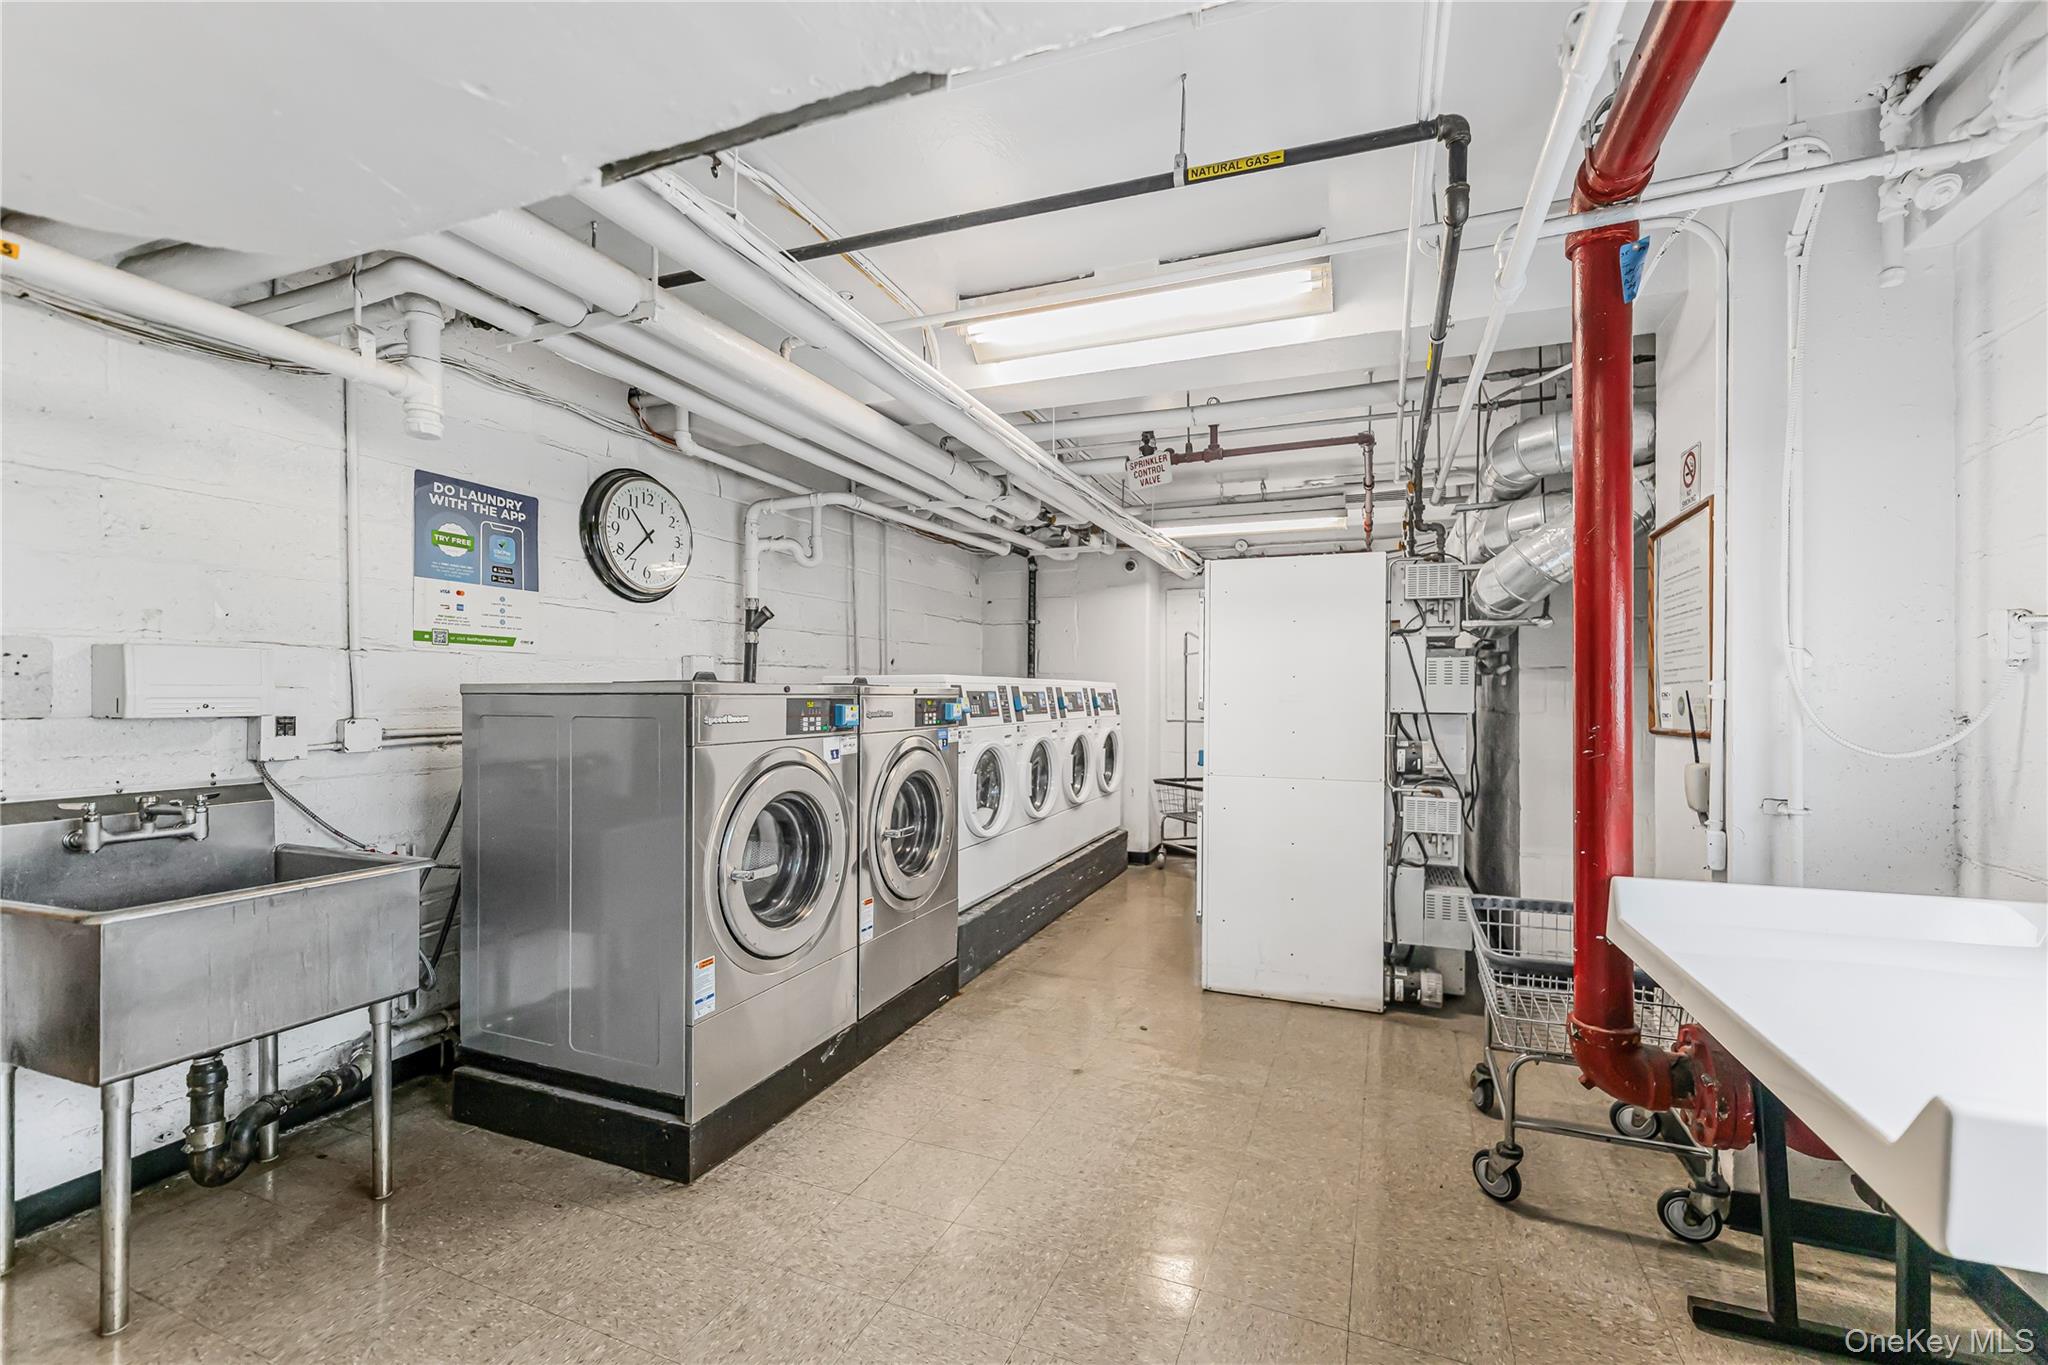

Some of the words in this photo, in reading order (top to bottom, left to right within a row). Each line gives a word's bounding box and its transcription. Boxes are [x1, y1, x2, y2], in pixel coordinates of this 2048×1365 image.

[1191, 162, 1243, 178] NATURAL
[1245, 154, 1270, 168] GAS
[1130, 454, 1168, 471] SPRINKLER
[1133, 464, 1166, 479] CONTROL
[1140, 475, 1161, 487] VALVE
[433, 482, 456, 496] DO
[460, 488, 523, 511] LAUNDRY
[629, 494, 639, 508] 11
[642, 492, 654, 507] 12
[429, 493, 468, 511] WITH
[471, 502, 497, 517] THE
[501, 509, 526, 522] APP
[617, 506, 630, 520] 10
[660, 502, 664, 514] 1
[611, 521, 620, 535] 9
[668, 516, 676, 528] 2
[434, 534, 450, 543] TRY
[451, 537, 472, 546] FREE
[674, 536, 681, 549] 3
[616, 542, 625, 555] 8
[629, 557, 637, 570] 7
[643, 566, 651, 579] 6
